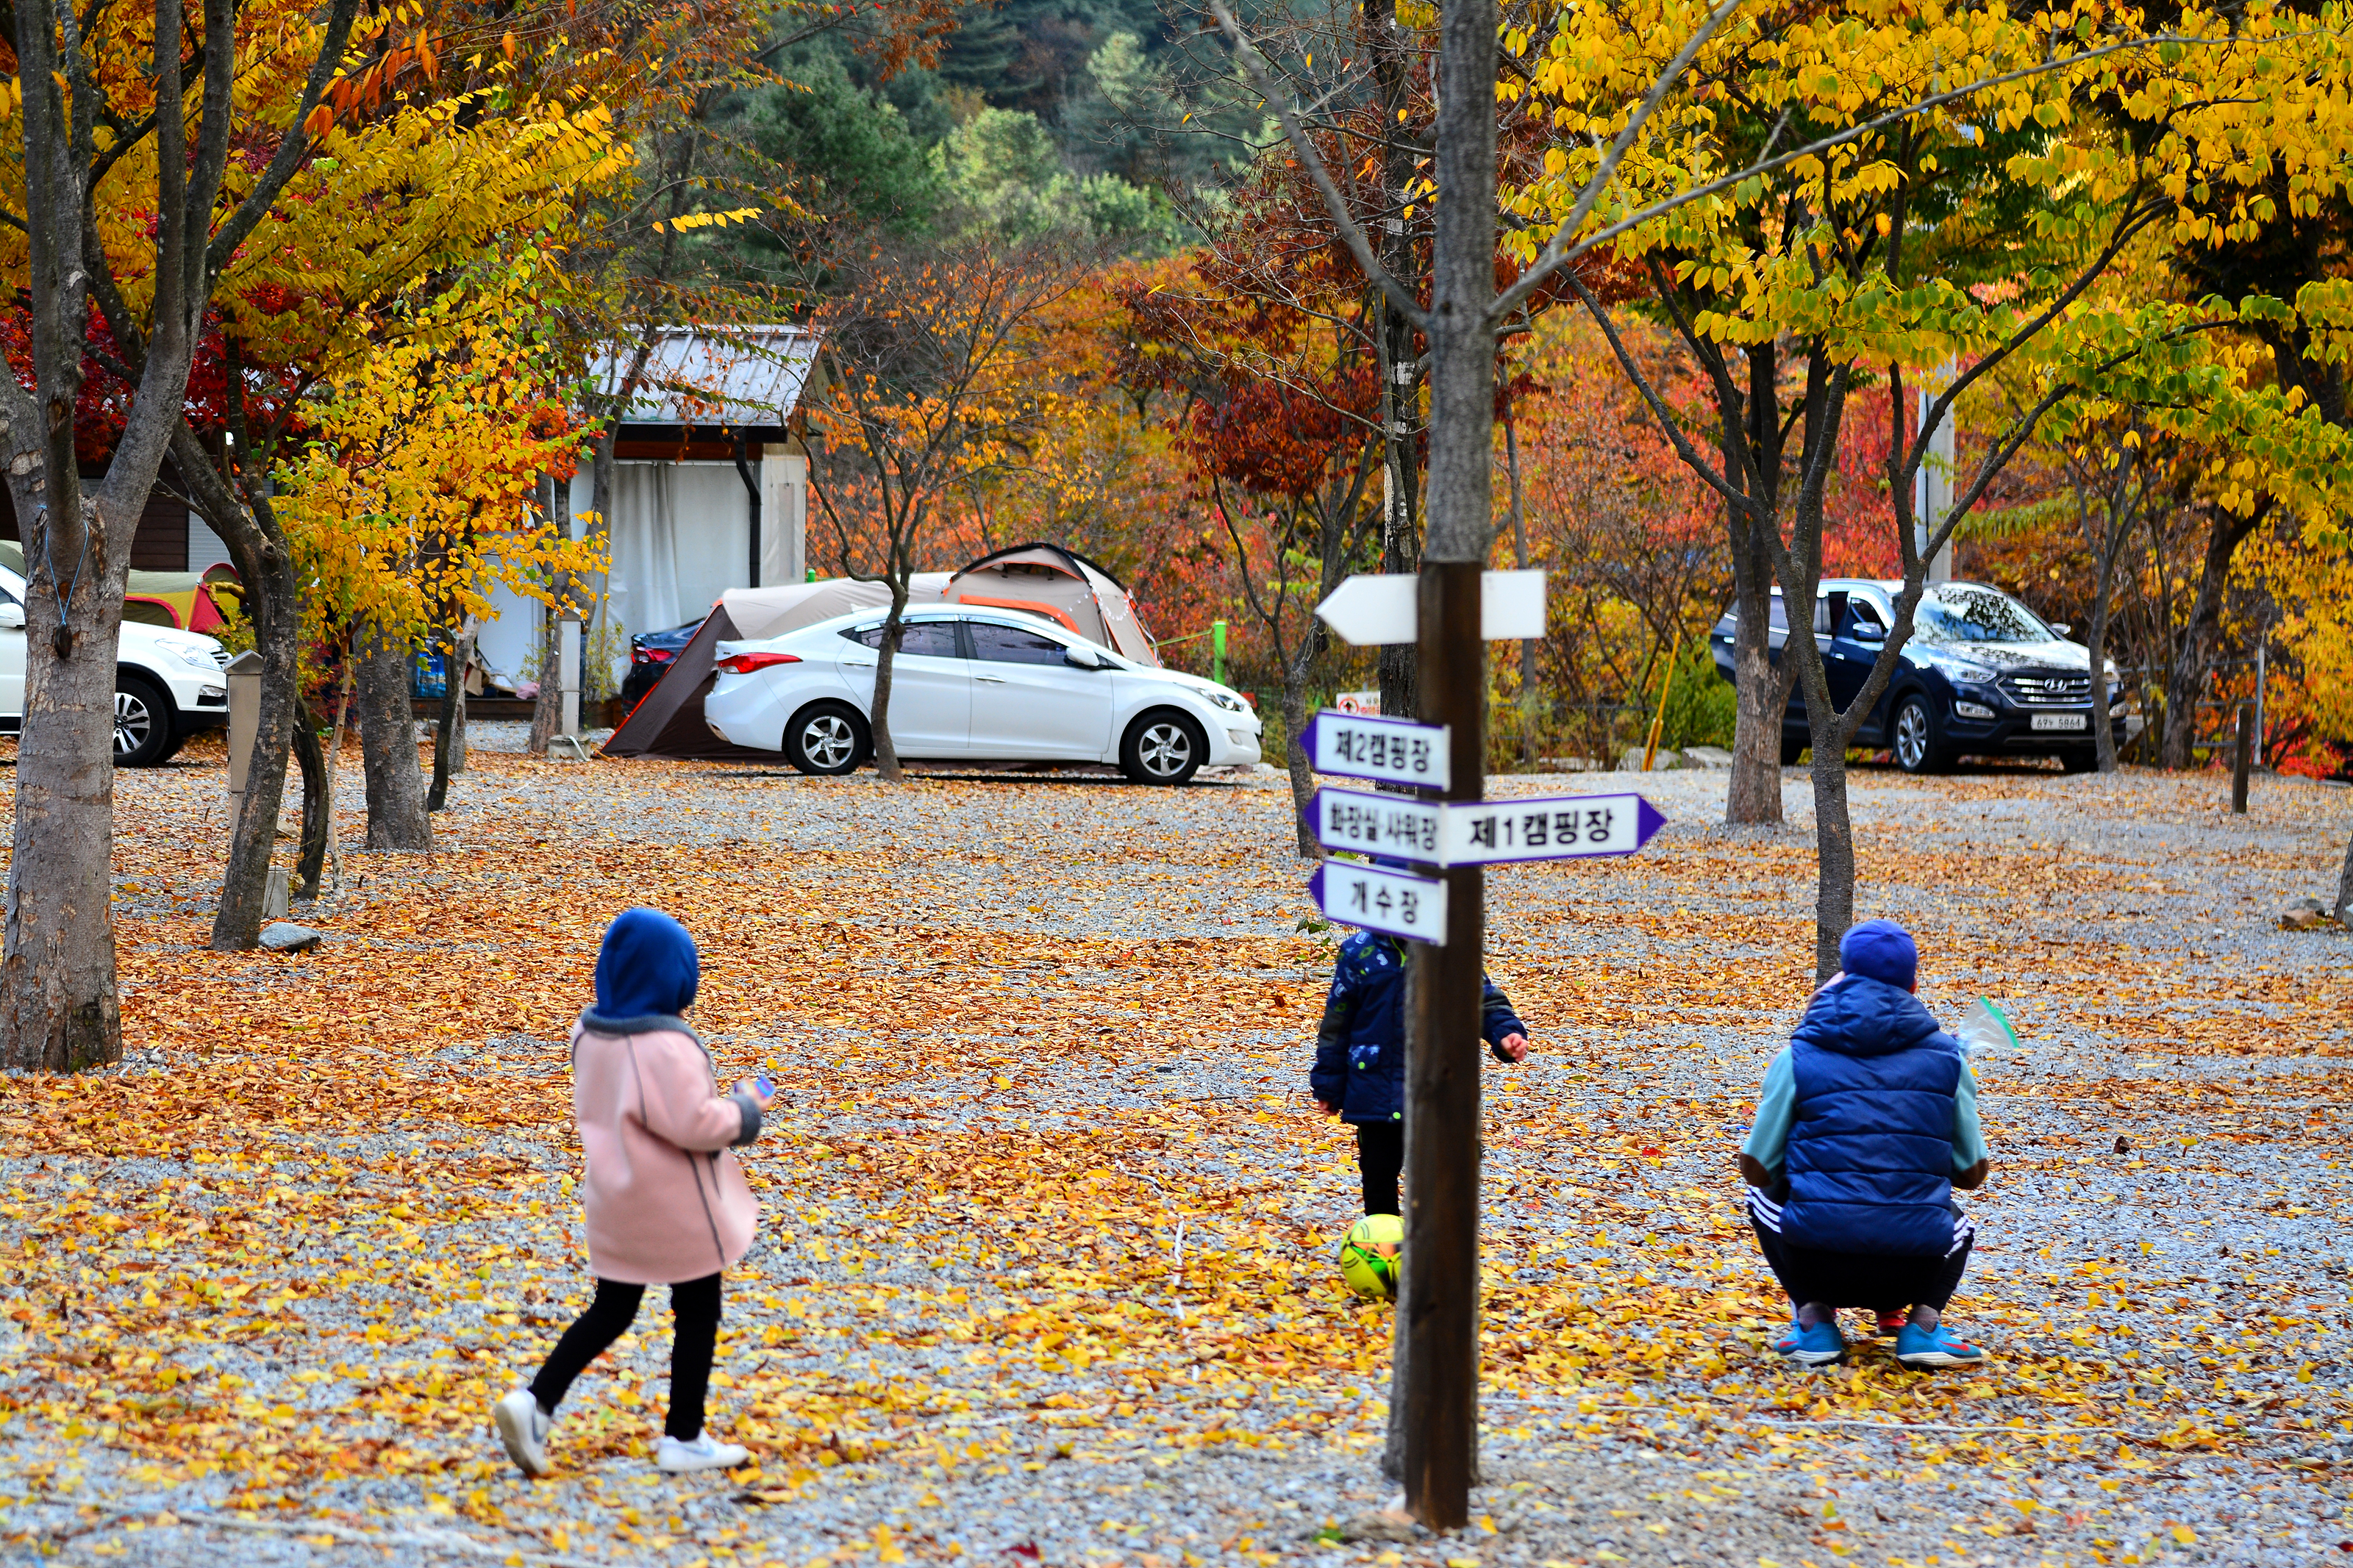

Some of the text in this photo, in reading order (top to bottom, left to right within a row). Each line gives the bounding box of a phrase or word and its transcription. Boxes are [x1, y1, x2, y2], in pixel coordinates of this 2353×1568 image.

[1335, 730, 1431, 773] 제2캠핑장
[1469, 809, 1613, 848] 제1캠핑장
[1351, 881, 1418, 923] 개수장
